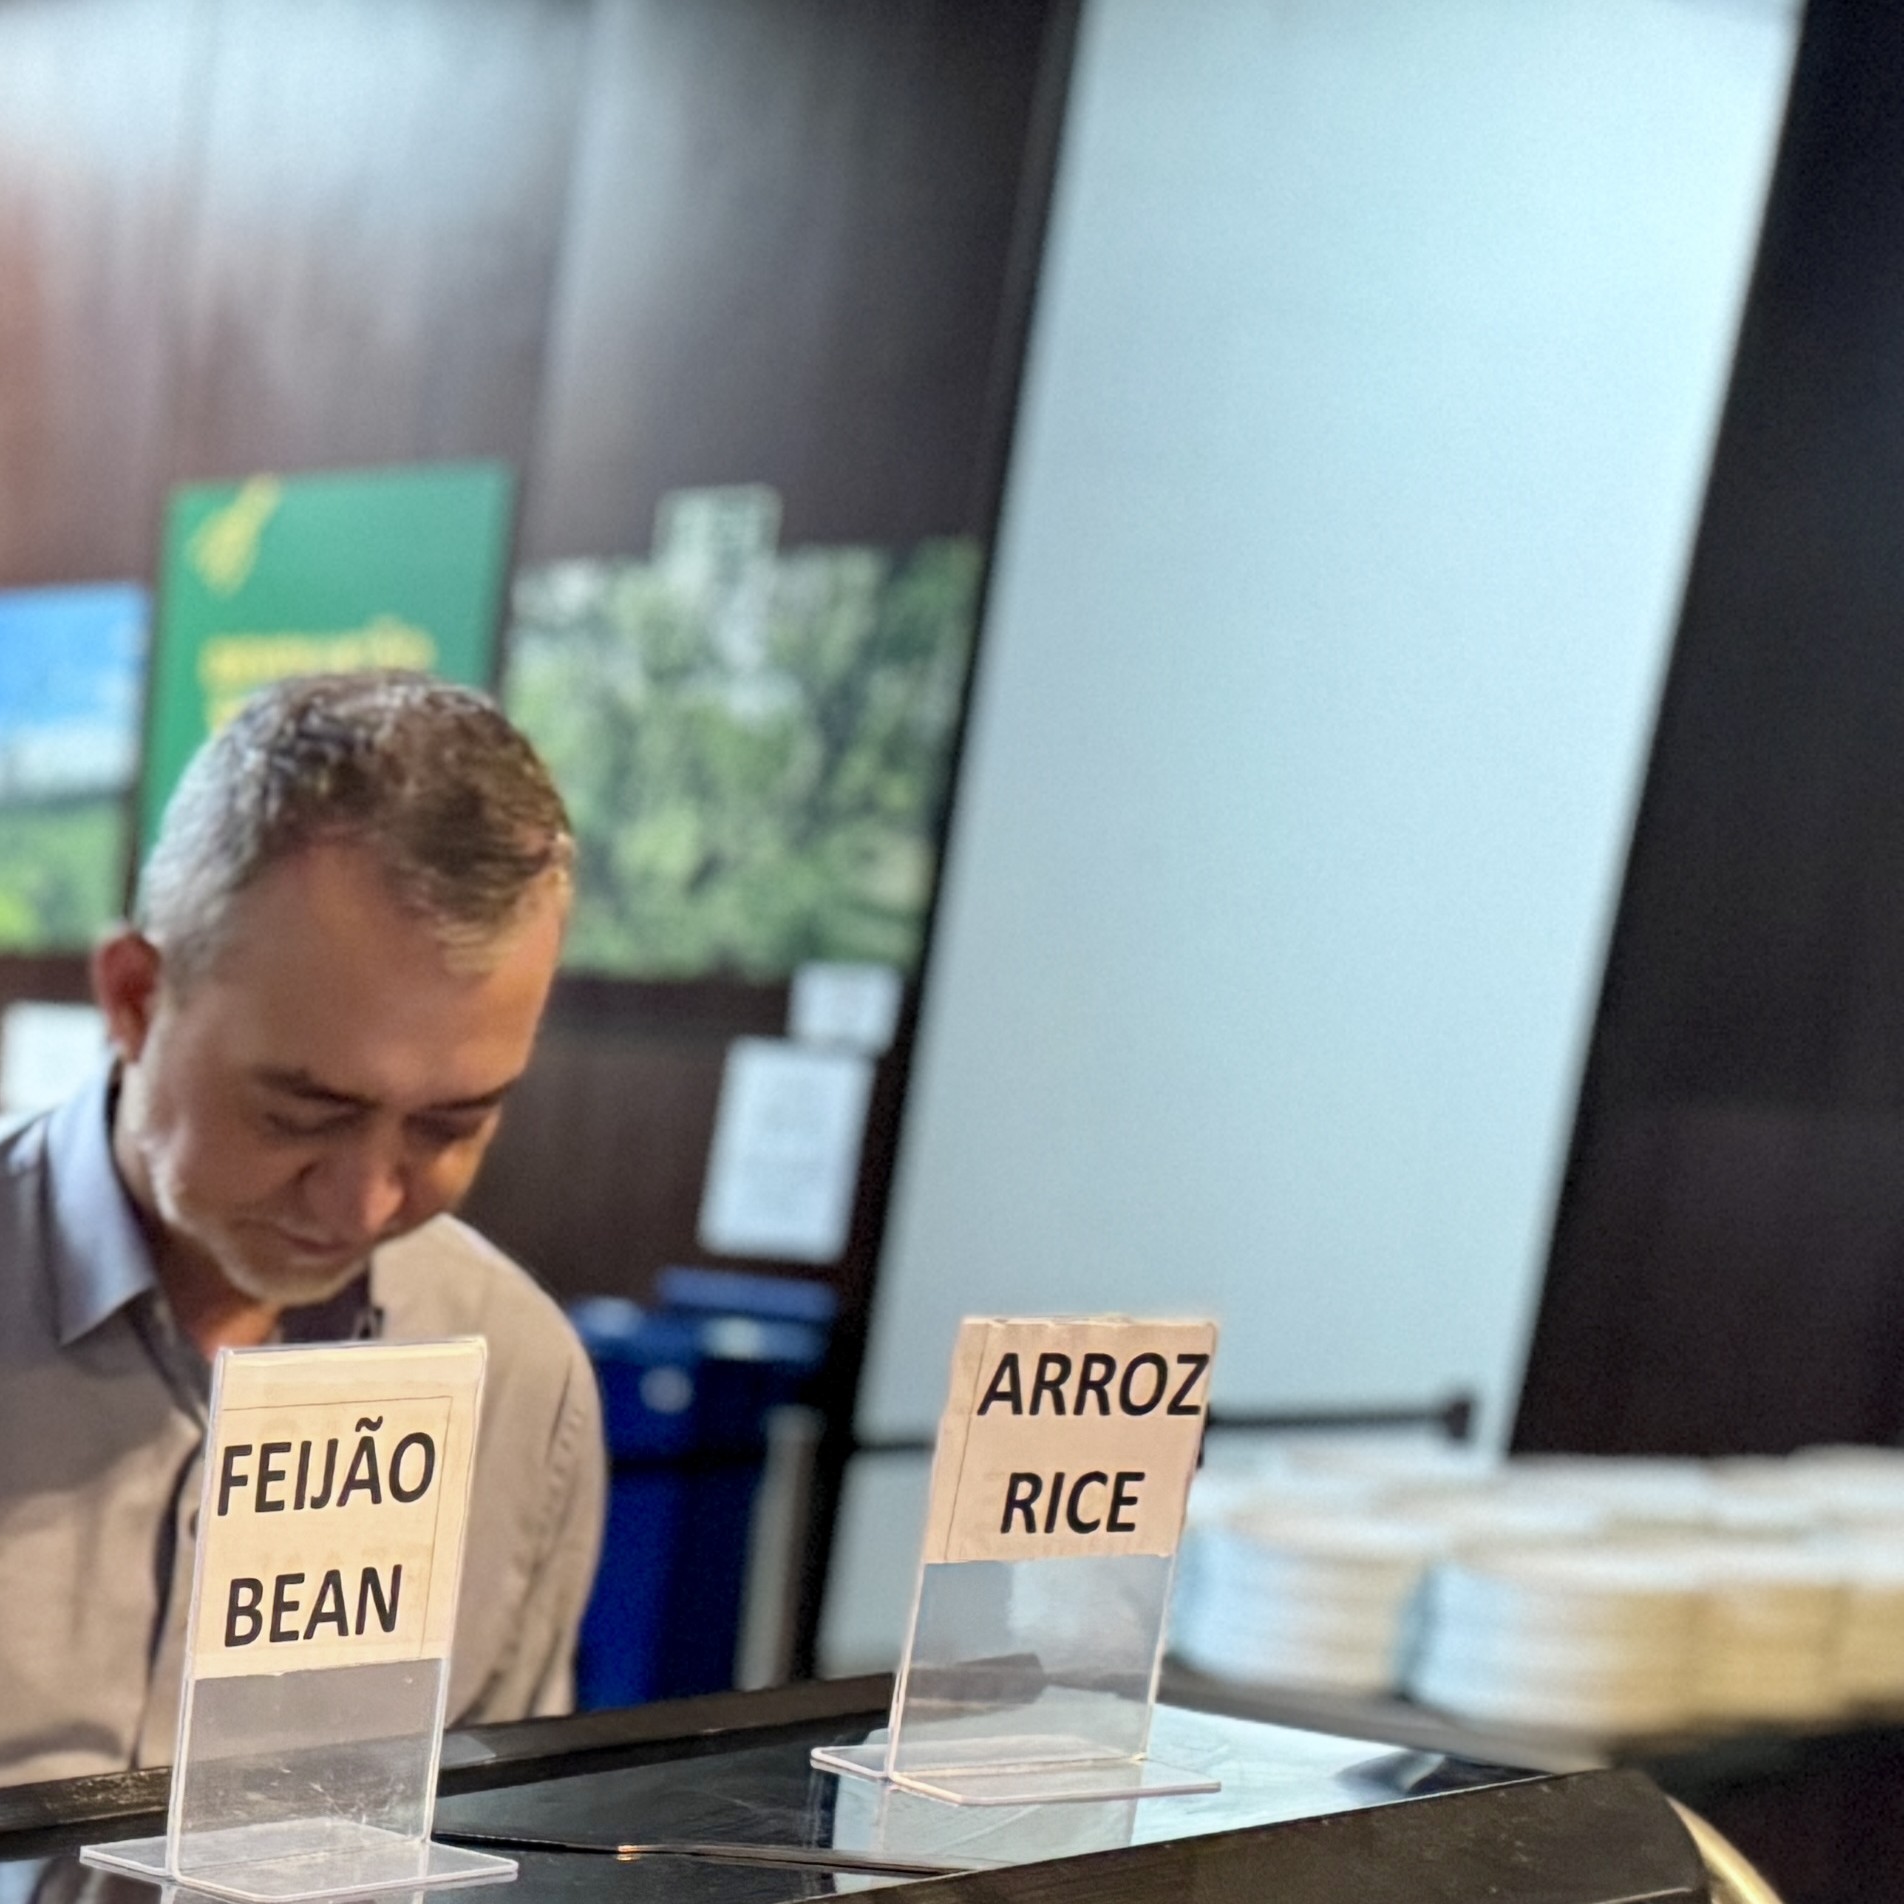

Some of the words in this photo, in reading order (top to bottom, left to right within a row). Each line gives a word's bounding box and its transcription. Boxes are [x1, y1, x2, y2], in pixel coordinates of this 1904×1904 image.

[977, 1352, 1210, 1416] ARROZ
[218, 1416, 435, 1516] FEIJÃO
[1001, 1471, 1145, 1534] RICE
[225, 1564, 402, 1647] BEAN
